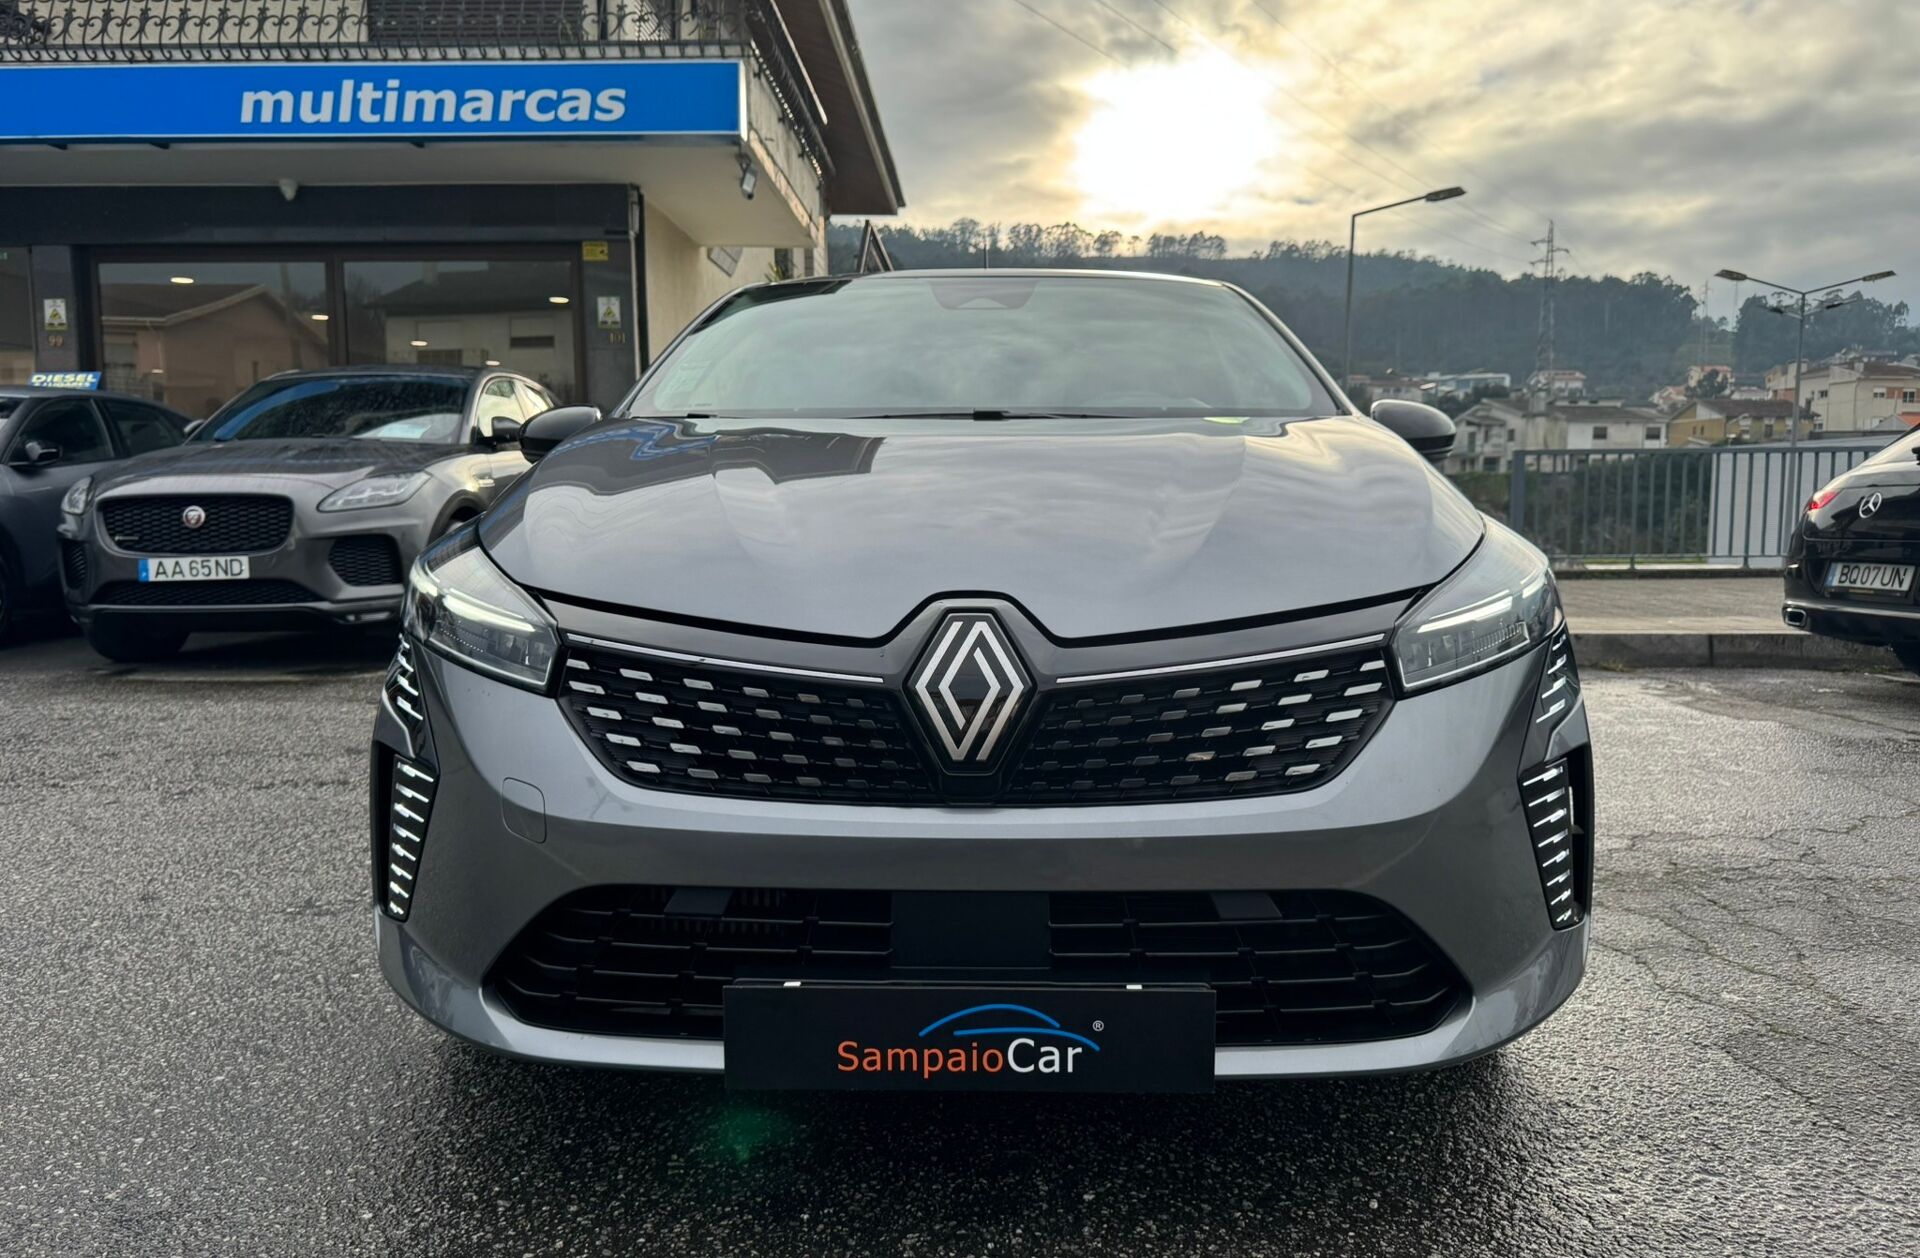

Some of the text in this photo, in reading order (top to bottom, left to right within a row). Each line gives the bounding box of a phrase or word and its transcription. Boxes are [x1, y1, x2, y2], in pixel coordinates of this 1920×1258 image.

[240, 79, 627, 124] multimarcas
[31, 373, 97, 384] DIESEL
[837, 1037, 1083, 1079] SampaioCar
